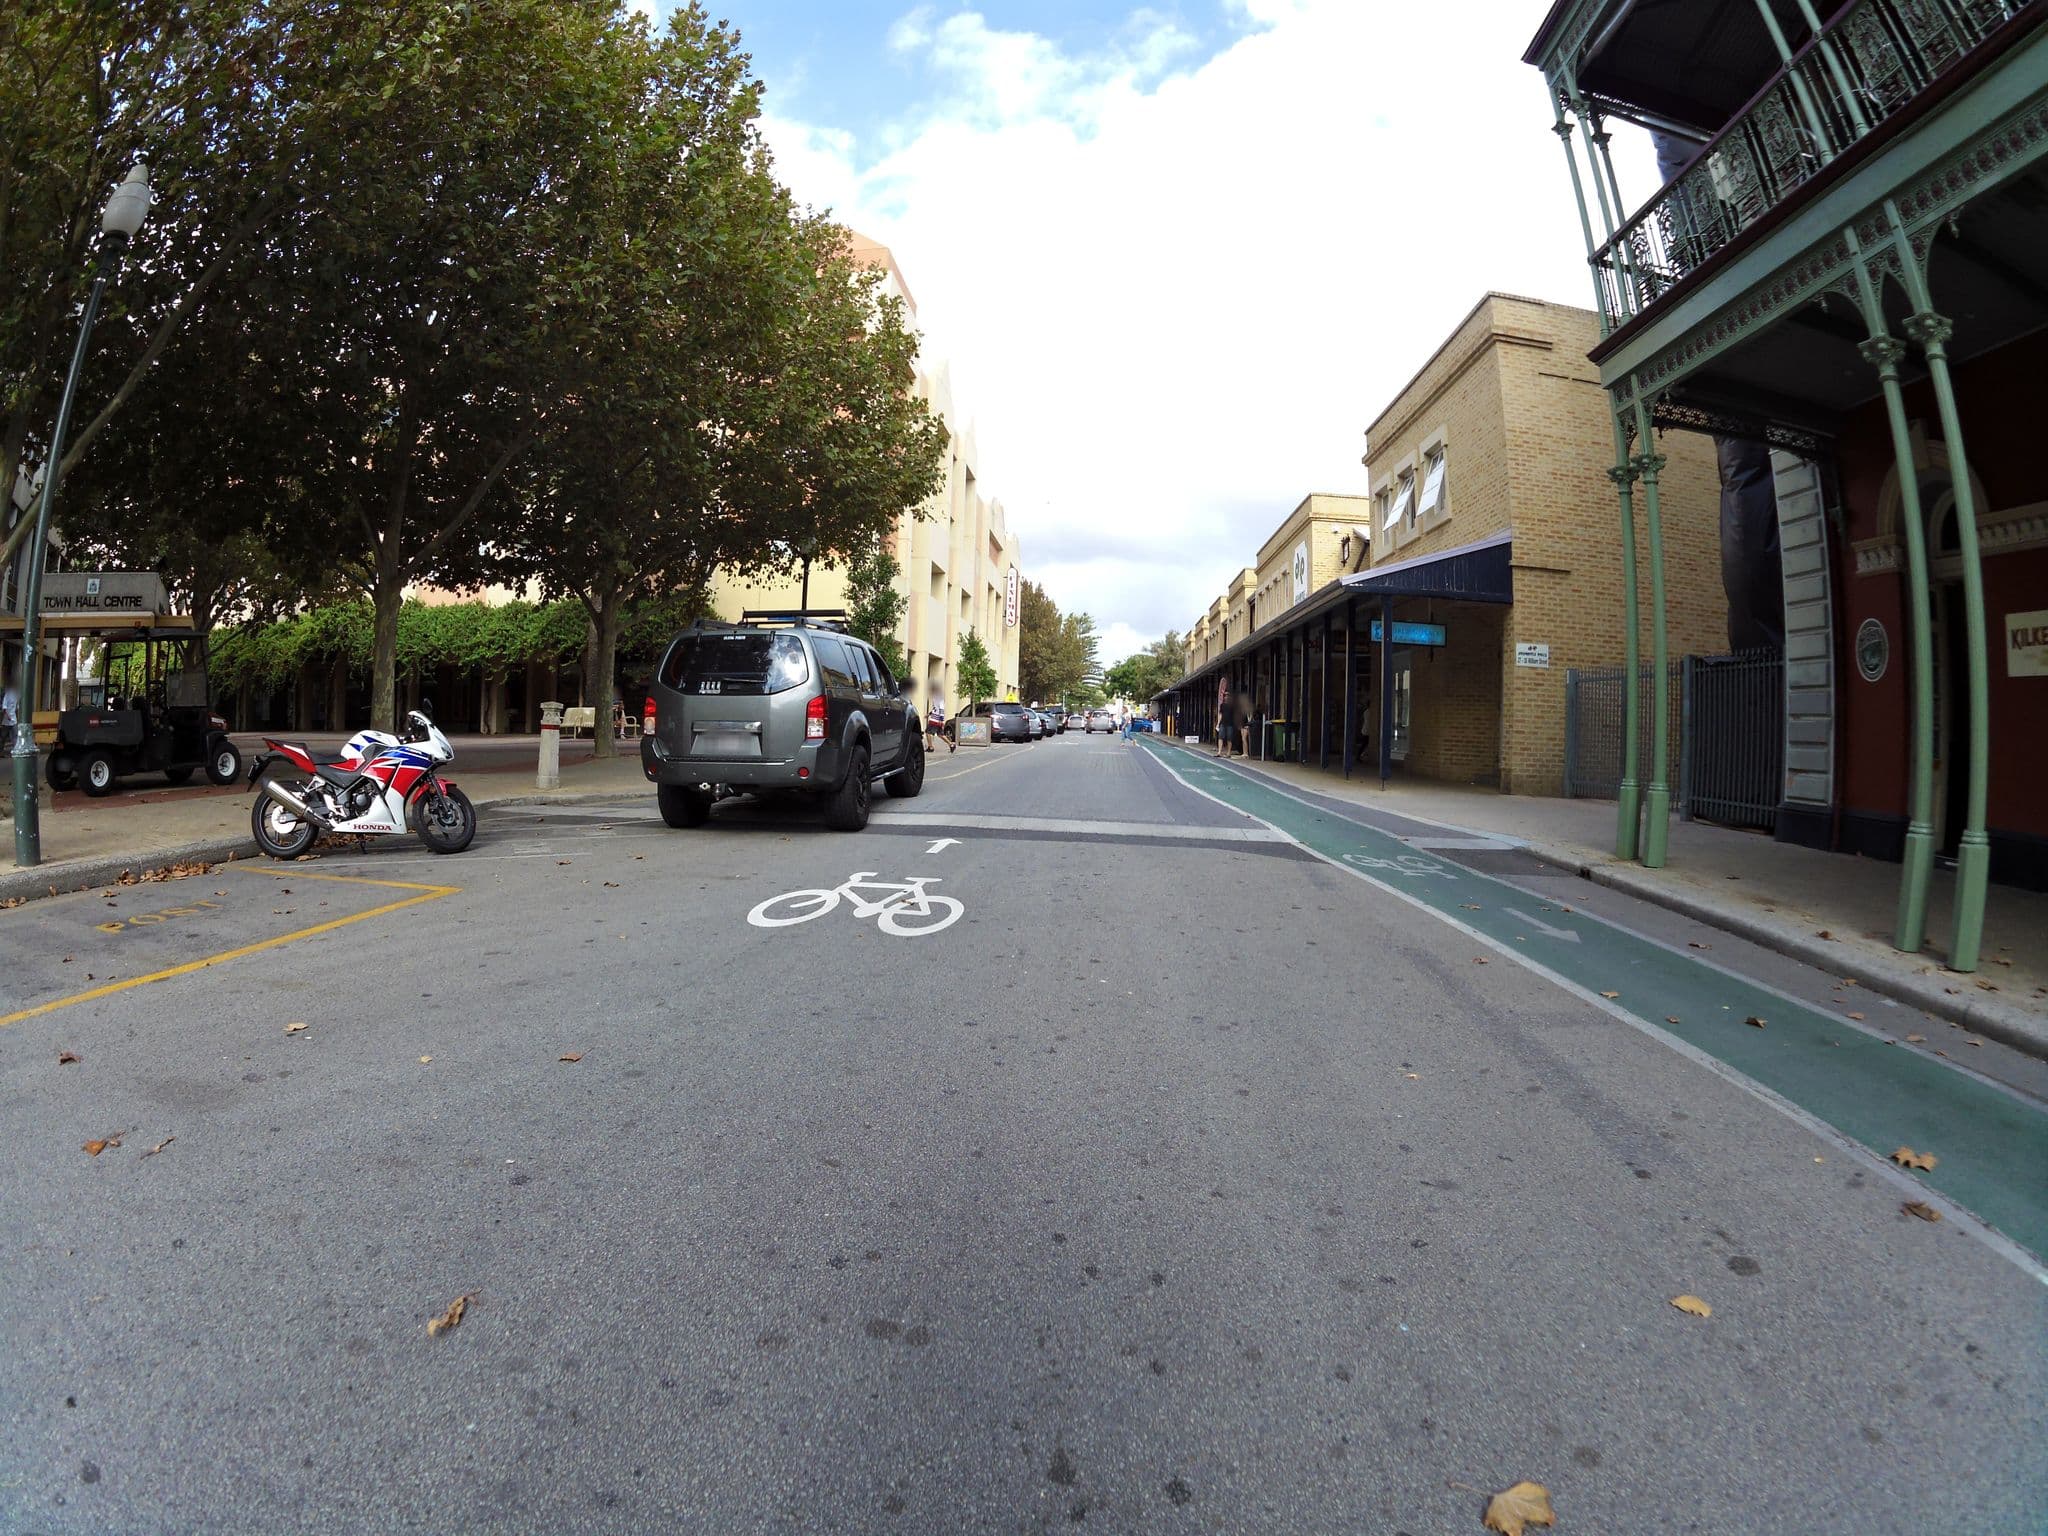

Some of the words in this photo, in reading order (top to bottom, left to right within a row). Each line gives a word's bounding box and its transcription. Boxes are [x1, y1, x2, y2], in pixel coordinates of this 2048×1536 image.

[44, 597, 71, 608] TOWN
[76, 596, 99, 607] HALL
[104, 596, 142, 607] CENTRE
